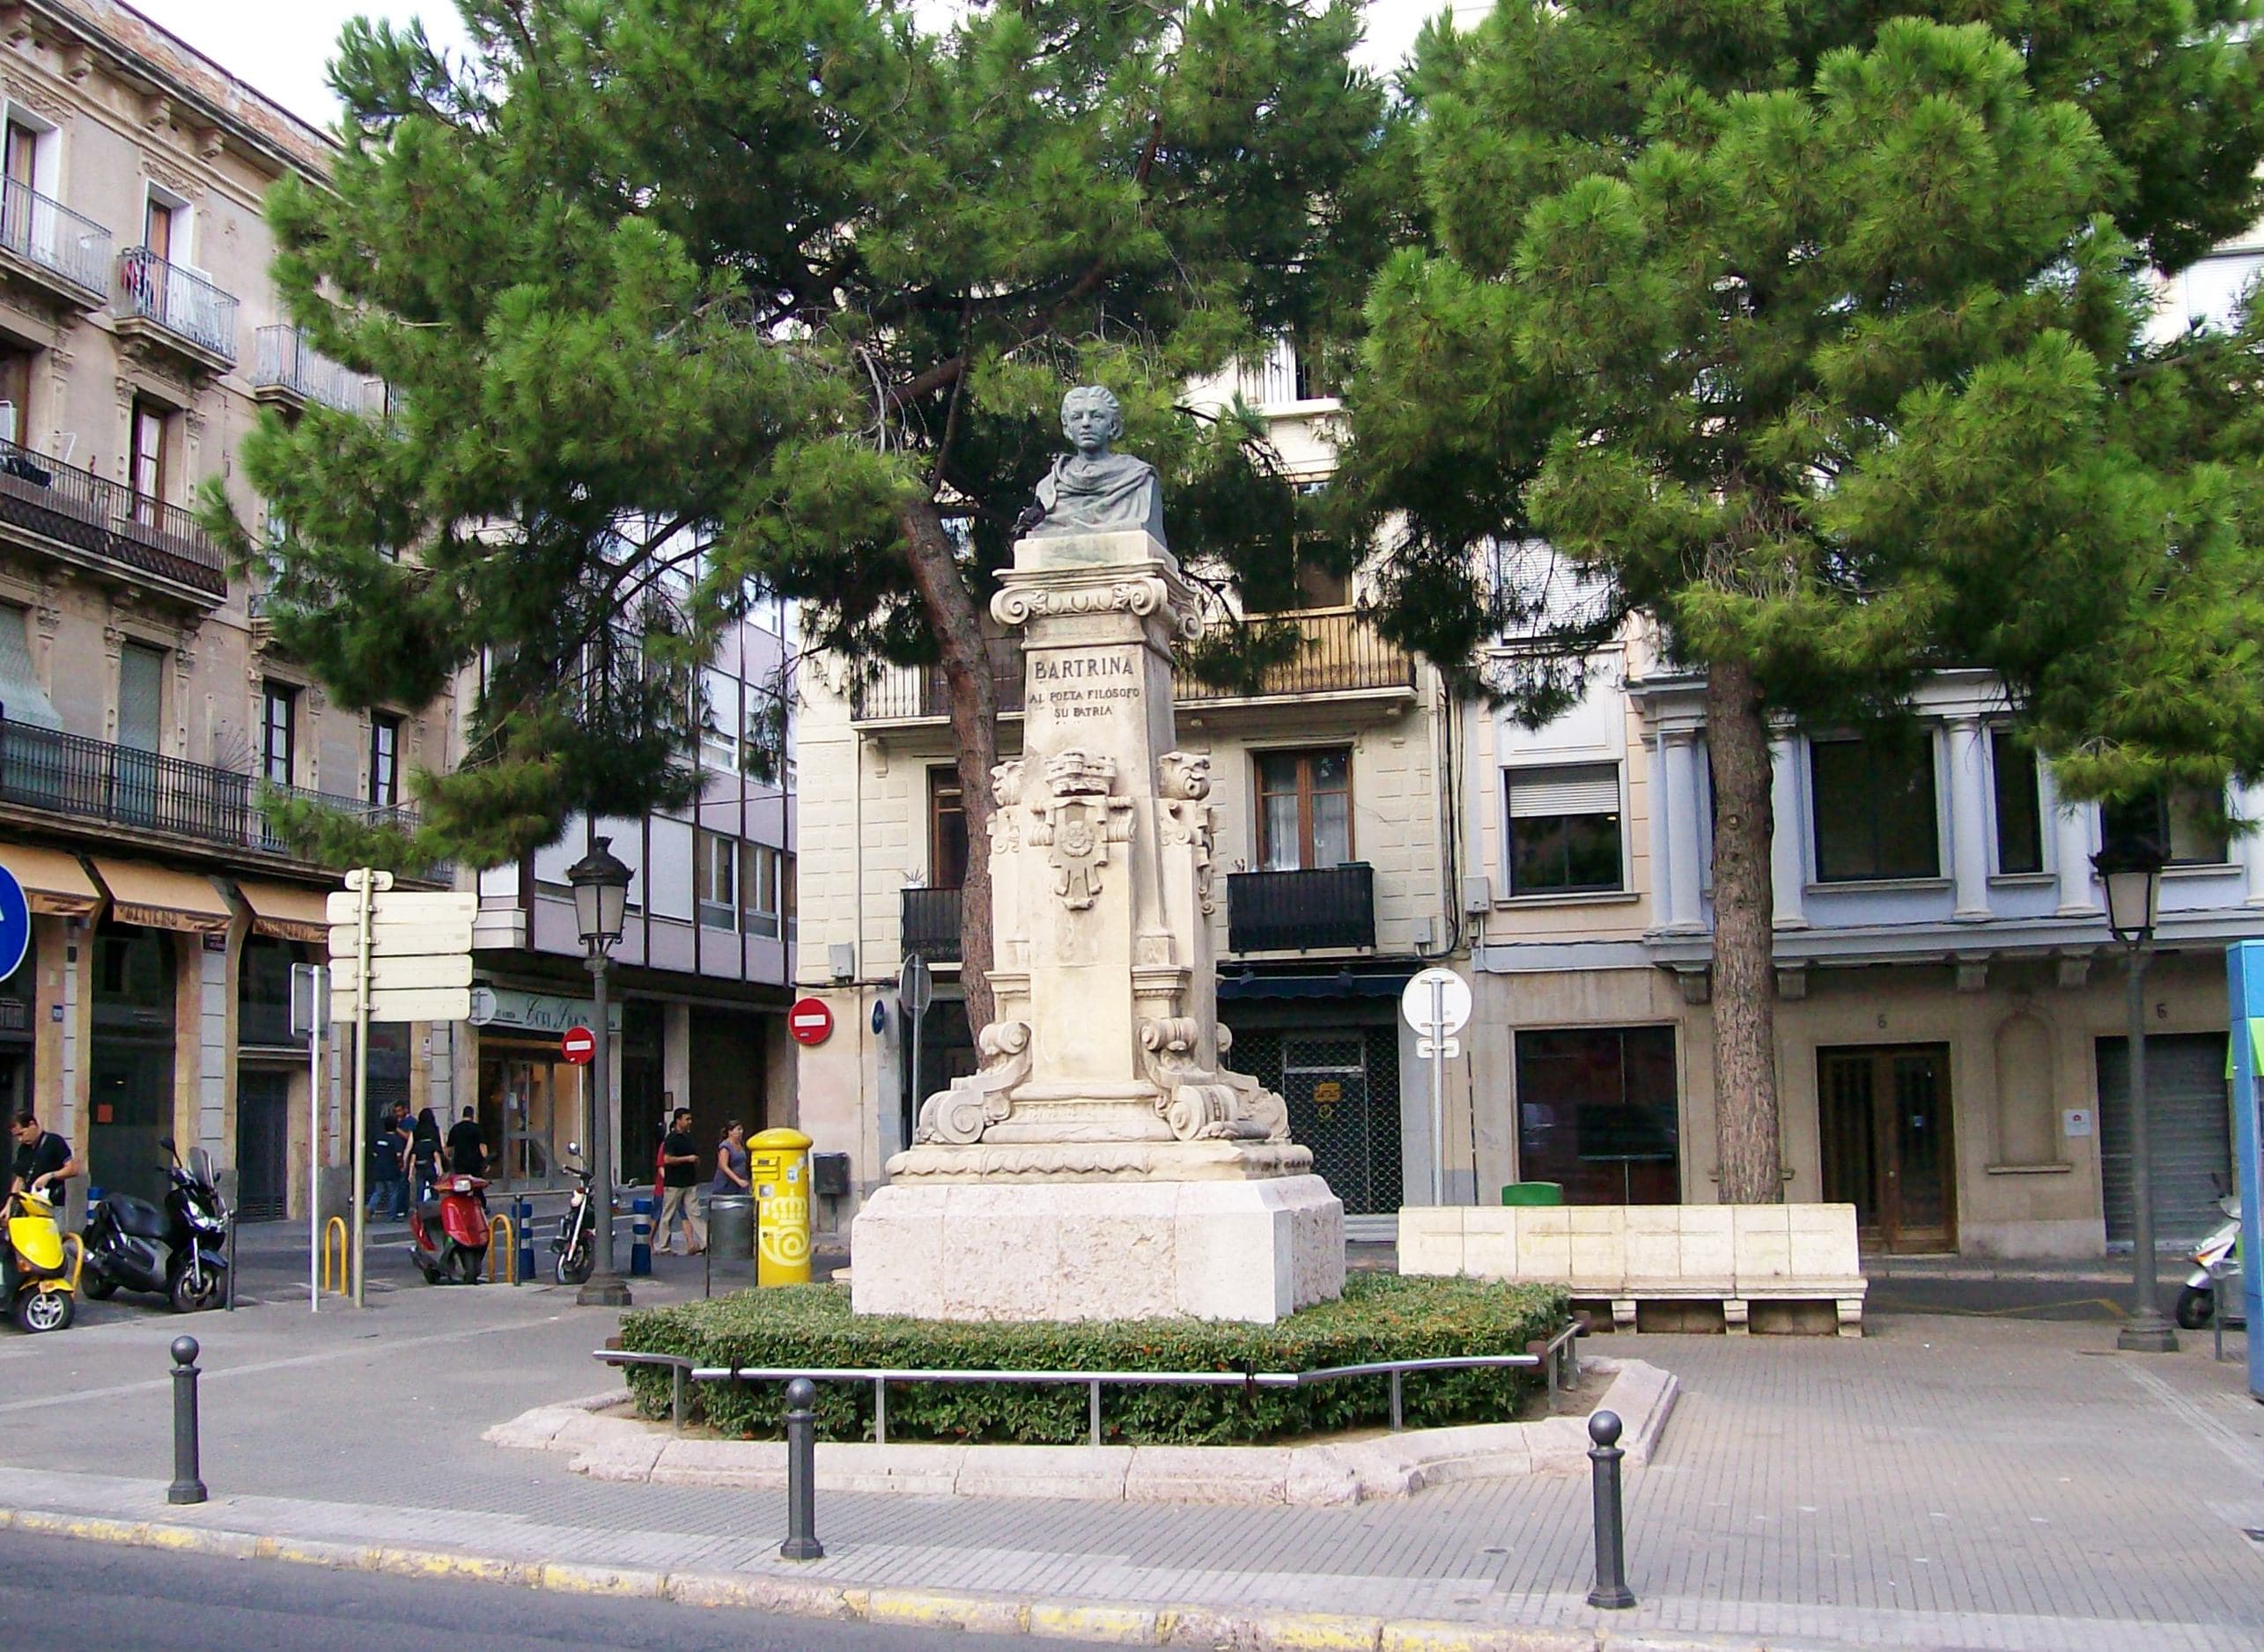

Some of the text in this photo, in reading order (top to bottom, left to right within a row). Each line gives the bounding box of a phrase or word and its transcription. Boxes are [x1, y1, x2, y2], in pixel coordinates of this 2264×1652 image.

[1034, 657, 1134, 679] BARTRINA
[1029, 694, 1044, 704] AL
[1050, 690, 1083, 702] POETA
[1054, 706, 1112, 718] SU PATRIA
